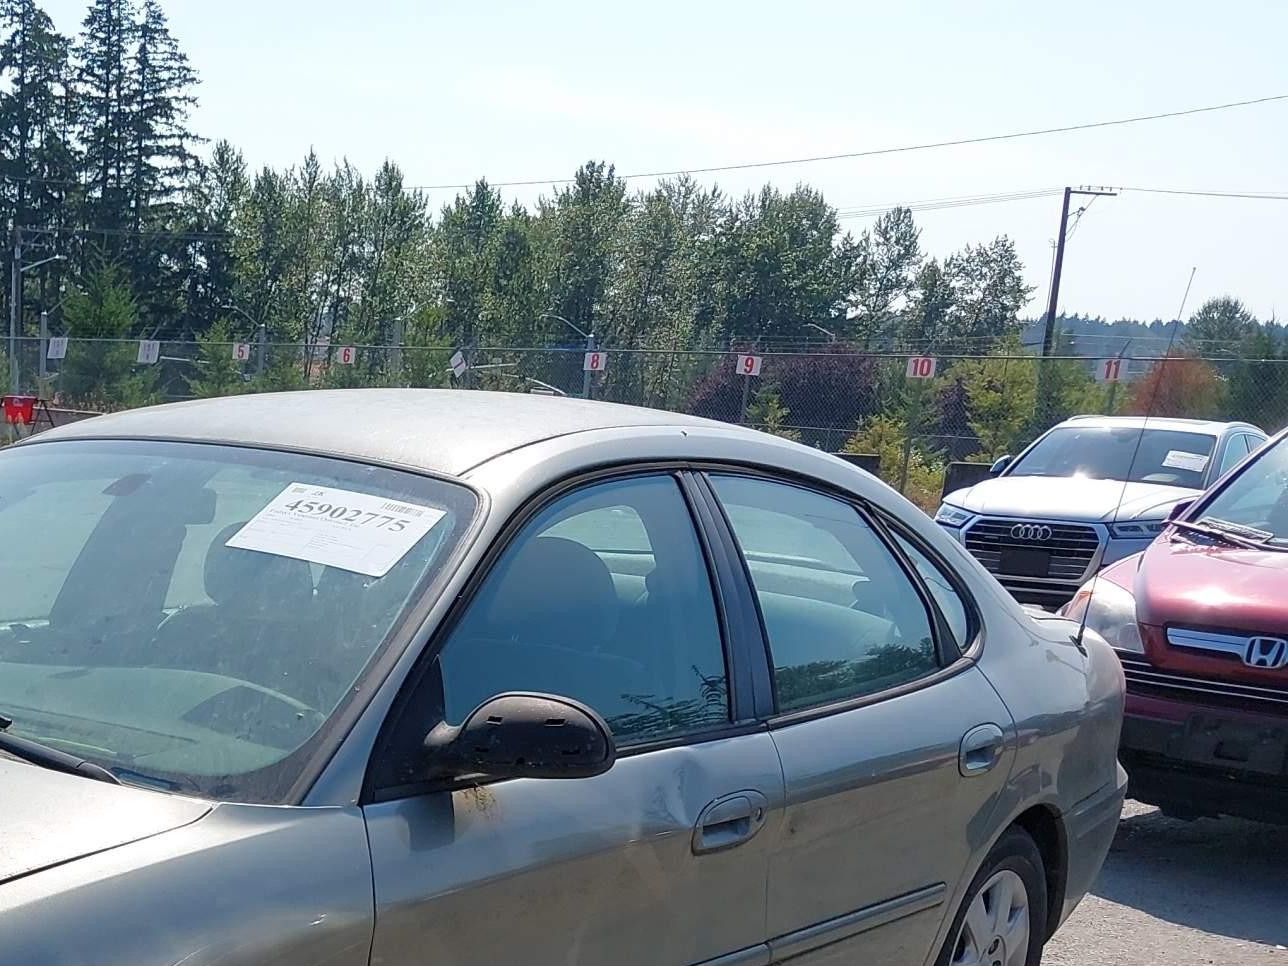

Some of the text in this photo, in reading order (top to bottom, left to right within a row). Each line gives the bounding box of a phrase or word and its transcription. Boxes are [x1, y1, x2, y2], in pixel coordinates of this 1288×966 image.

[237, 345, 245, 359] 5
[343, 347, 351, 363] 6
[591, 353, 600, 369] 8
[744, 356, 755, 374] 9
[912, 358, 932, 377] 10
[1105, 359, 1121, 379] 11
[284, 499, 412, 532] 45902775
